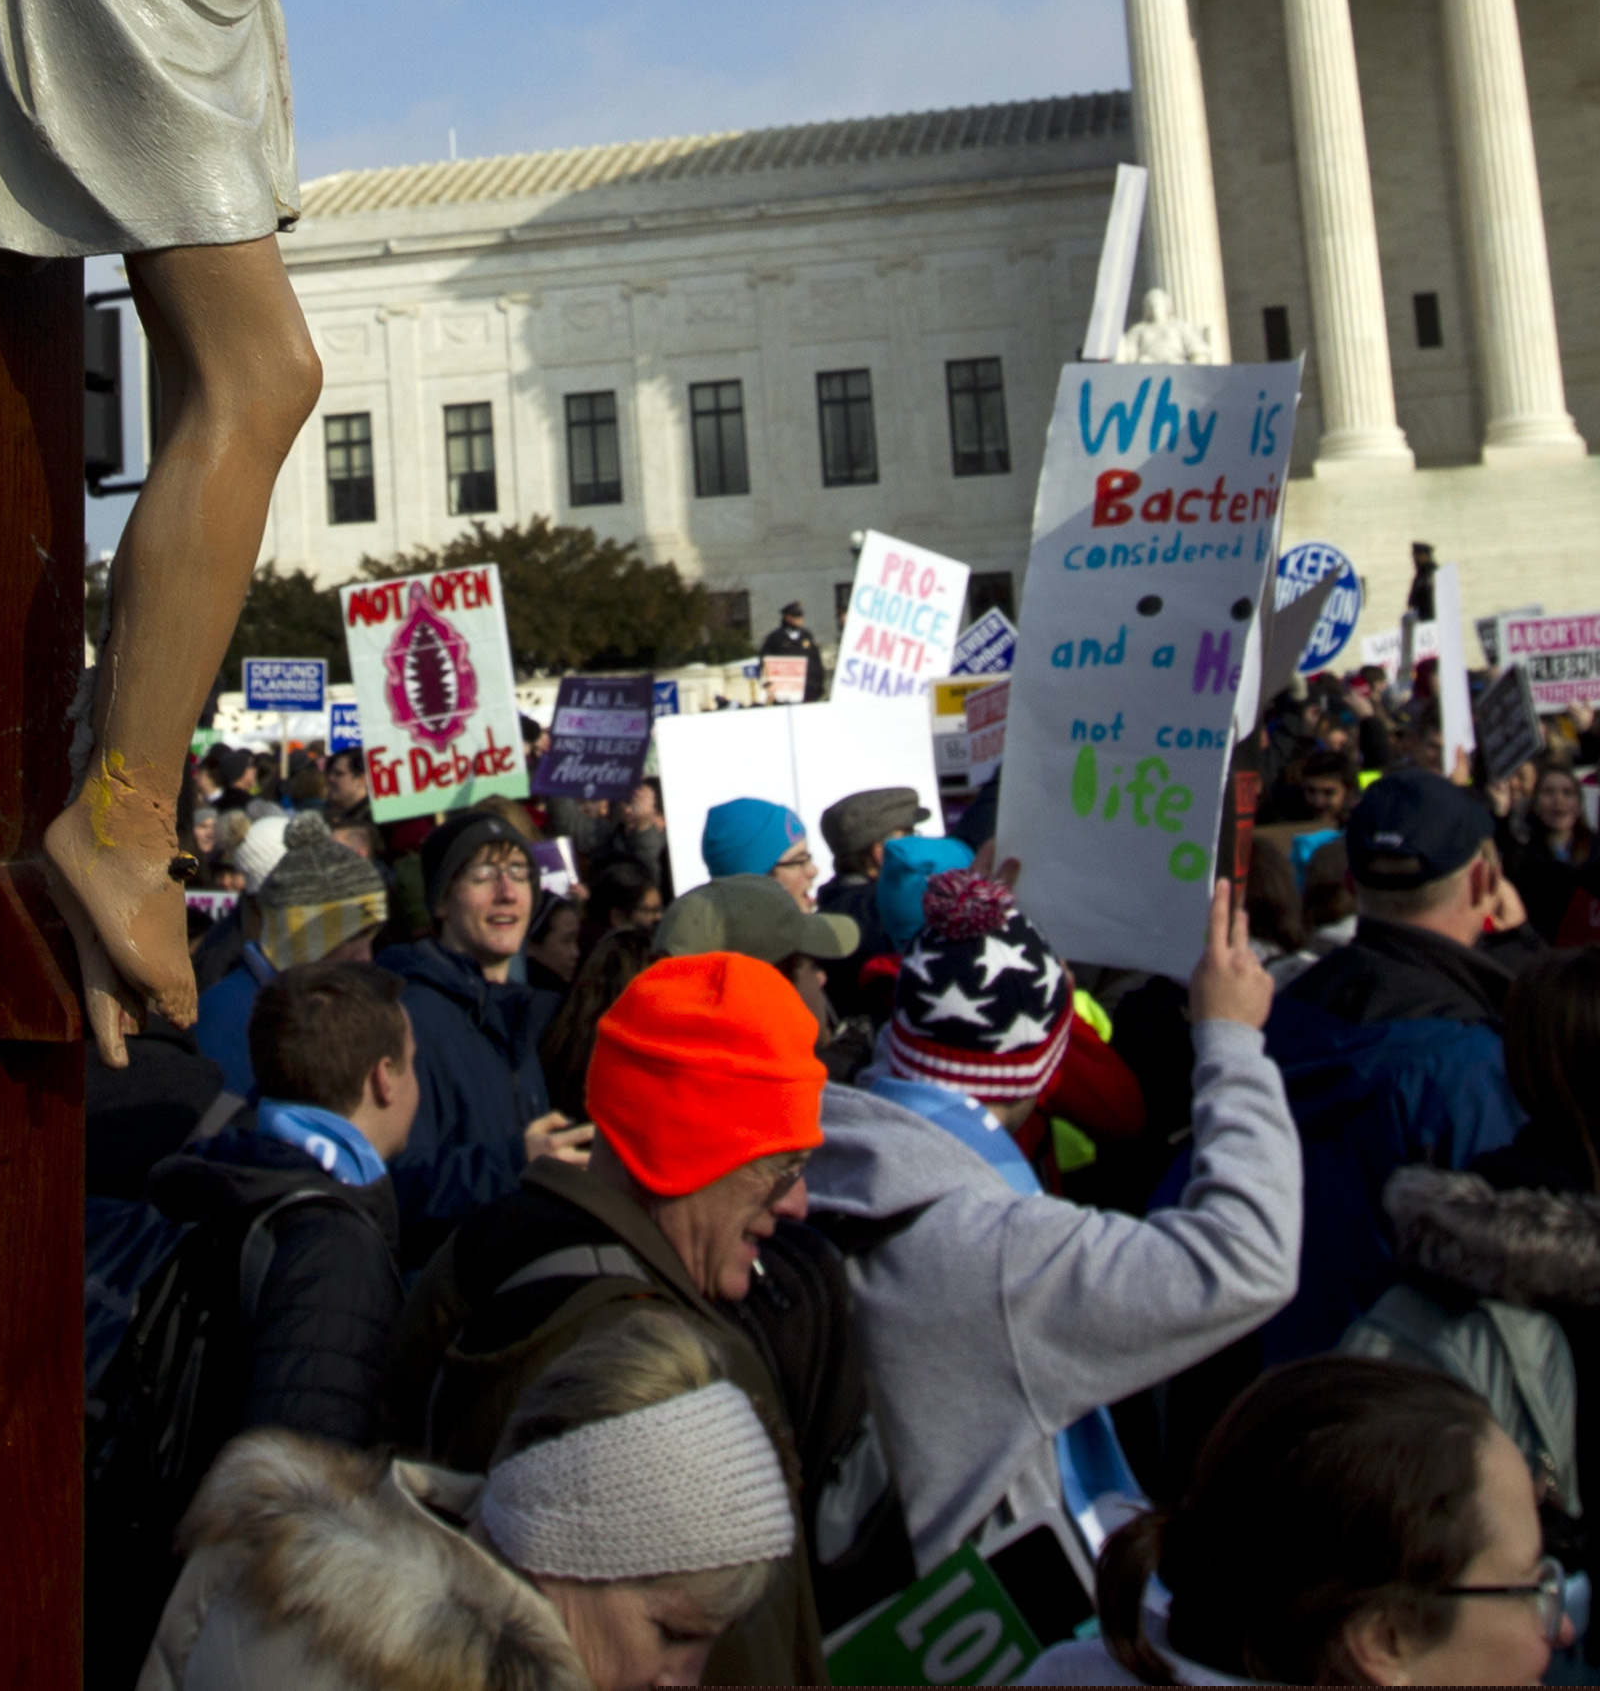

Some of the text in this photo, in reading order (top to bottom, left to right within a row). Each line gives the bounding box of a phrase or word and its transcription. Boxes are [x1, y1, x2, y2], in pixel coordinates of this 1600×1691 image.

[1078, 376, 1284, 466] Why is
[1062, 528, 1244, 572] considered
[348, 569, 492, 627] NOT OPEN
[880, 551, 947, 601] PRO-
[854, 624, 934, 675] ANTI-
[1051, 624, 1128, 670] and
[1151, 643, 1176, 669] a
[250, 664, 320, 679] DEFUND
[250, 678, 321, 692] PLANNED
[1070, 711, 1125, 743] not
[365, 724, 516, 801] For Debate
[550, 753, 635, 784] Abortion
[1069, 743, 1195, 835] life
